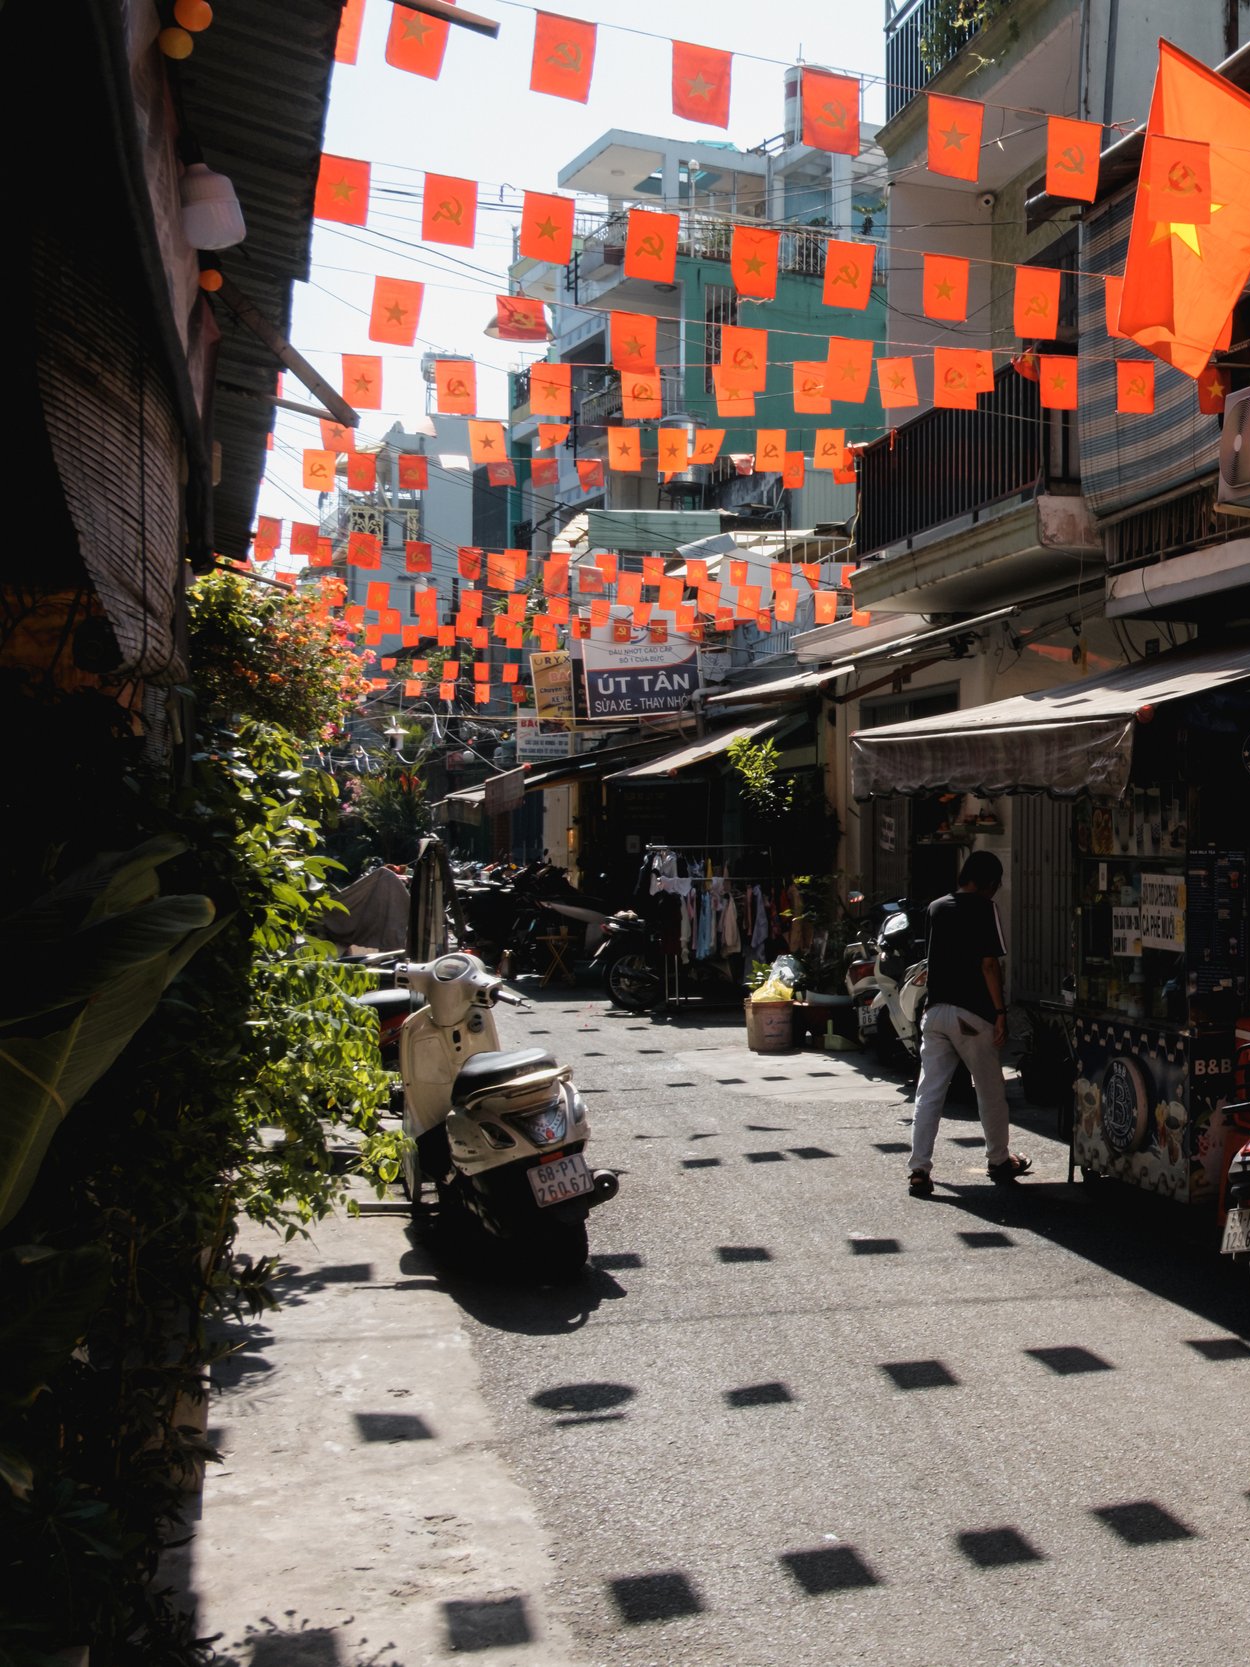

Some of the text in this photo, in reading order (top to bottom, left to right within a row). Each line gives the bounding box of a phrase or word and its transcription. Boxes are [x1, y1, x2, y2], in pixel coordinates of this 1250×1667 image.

[597, 673, 631, 695] ÚT
[638, 670, 690, 692] TÂN
[595, 697, 618, 713] SỬA
[619, 698, 633, 711] XE
[640, 696, 665, 710] THAY
[1194, 1058, 1232, 1076] B&B
[537, 1158, 577, 1184] 68-P1
